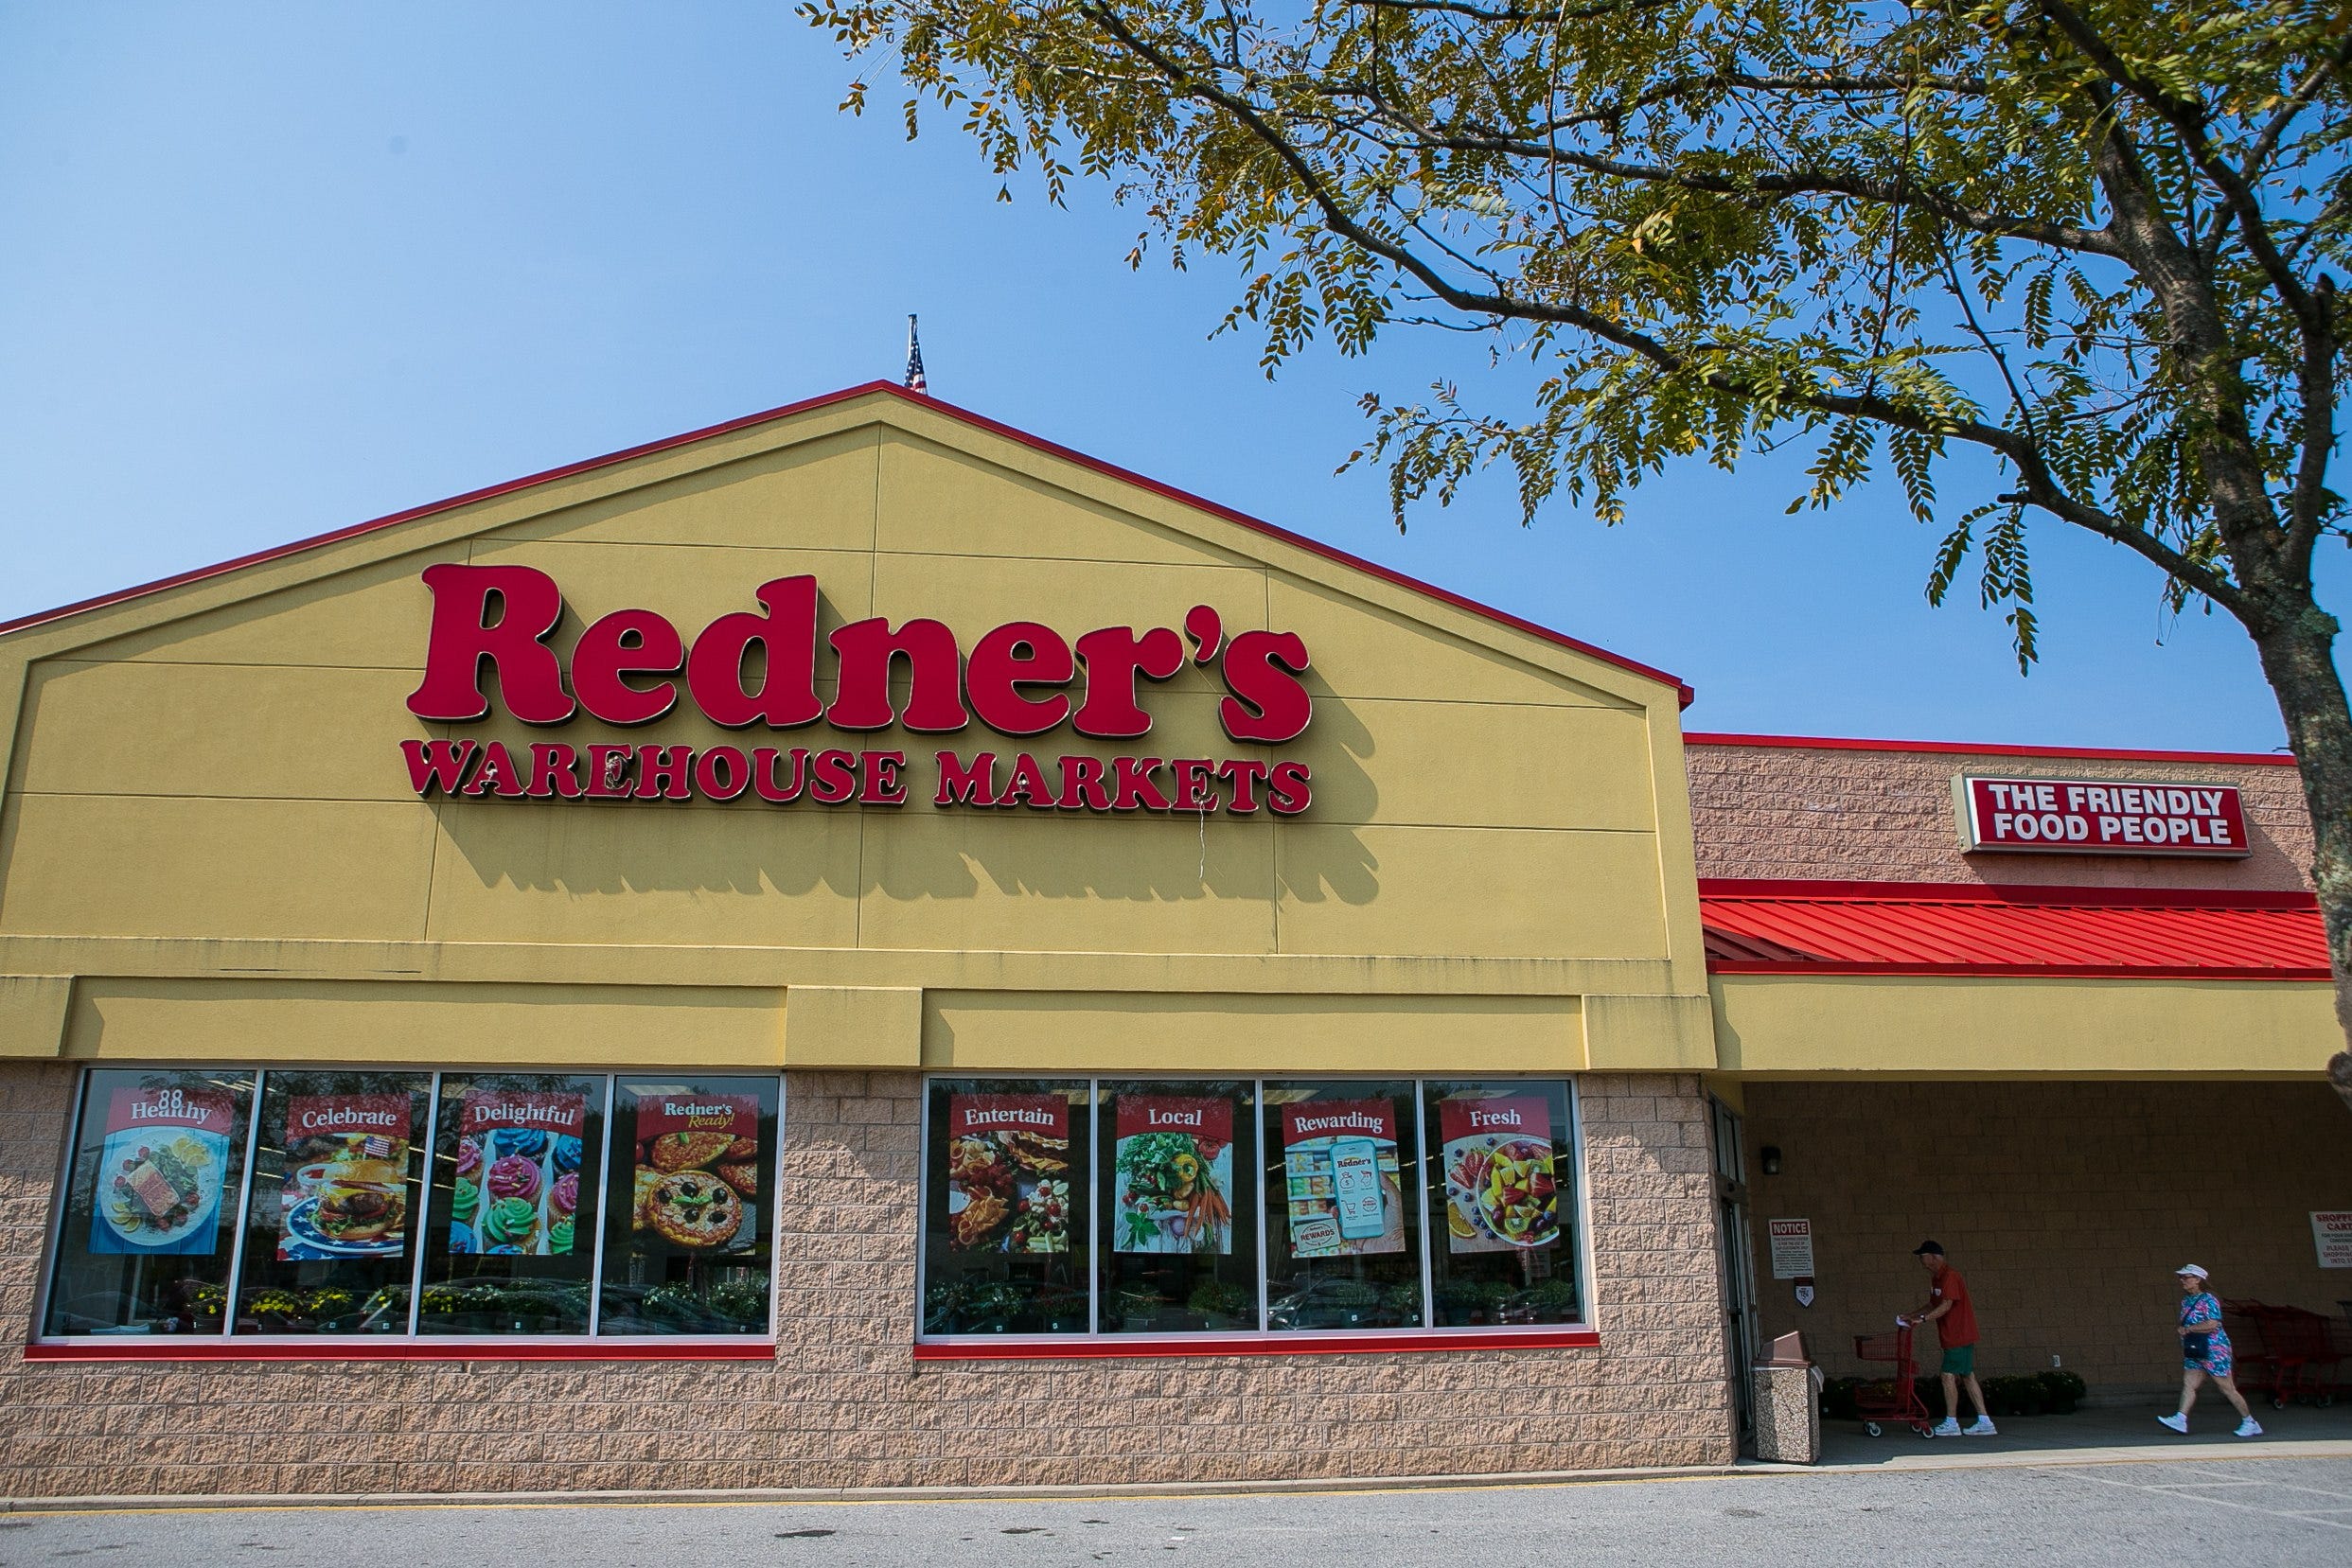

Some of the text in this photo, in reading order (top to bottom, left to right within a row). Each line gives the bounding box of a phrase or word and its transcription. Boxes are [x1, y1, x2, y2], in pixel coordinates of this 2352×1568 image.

[405, 563, 1312, 744] Redner's
[398, 739, 1312, 817] WAREHOUSE MARKETS
[1989, 784, 2223, 816] THE FRIENDLY
[1993, 812, 2232, 844] FOOD PEOPLE
[158, 1089, 183, 1110] 88
[664, 1102, 733, 1117] Redner's
[302, 1108, 398, 1128] Celebrate
[474, 1102, 575, 1126] Delightful
[688, 1113, 735, 1129] Ready!
[964, 1107, 1055, 1126] Entertain
[1148, 1108, 1202, 1126] Local
[1295, 1111, 1384, 1135] Rewarding
[1470, 1109, 1522, 1127] Fresh
[1300, 1228, 1335, 1242] REWARDS
[1773, 1224, 1807, 1234] NOTICE
